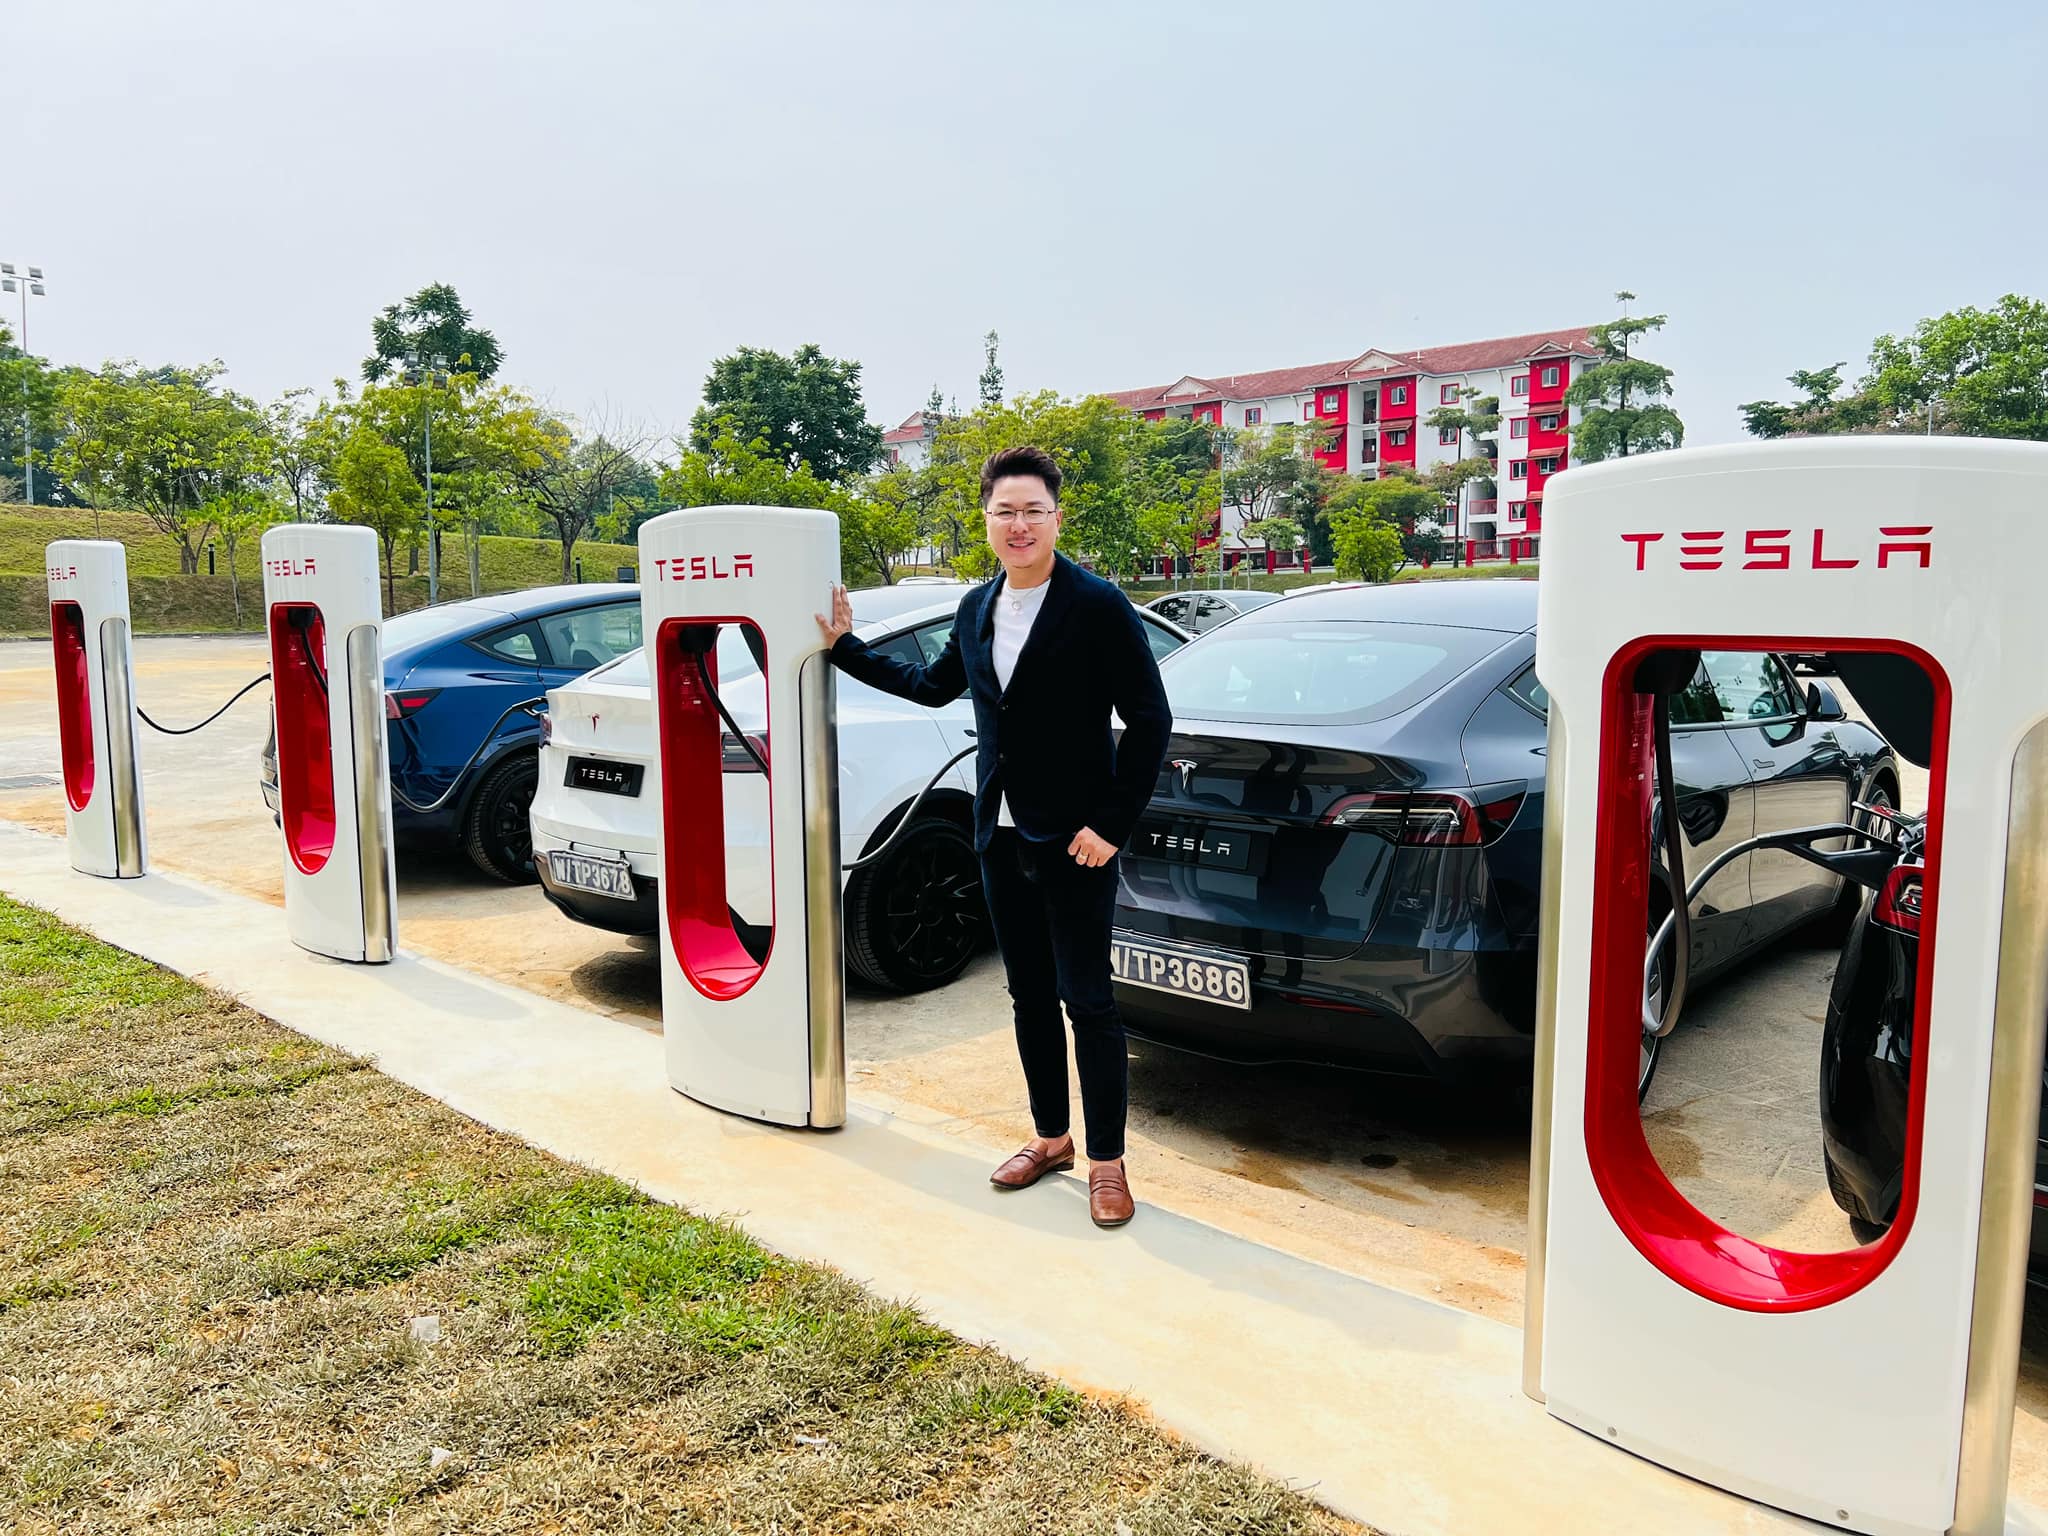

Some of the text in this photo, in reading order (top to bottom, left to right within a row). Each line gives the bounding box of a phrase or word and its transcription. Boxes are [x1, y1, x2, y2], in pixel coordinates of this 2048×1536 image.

[1620, 526, 1933, 571] TESLA
[266, 558, 316, 577] TESLA
[654, 554, 753, 582] TESLA
[581, 768, 623, 783] TESLA
[1150, 833, 1231, 856] TESLA
